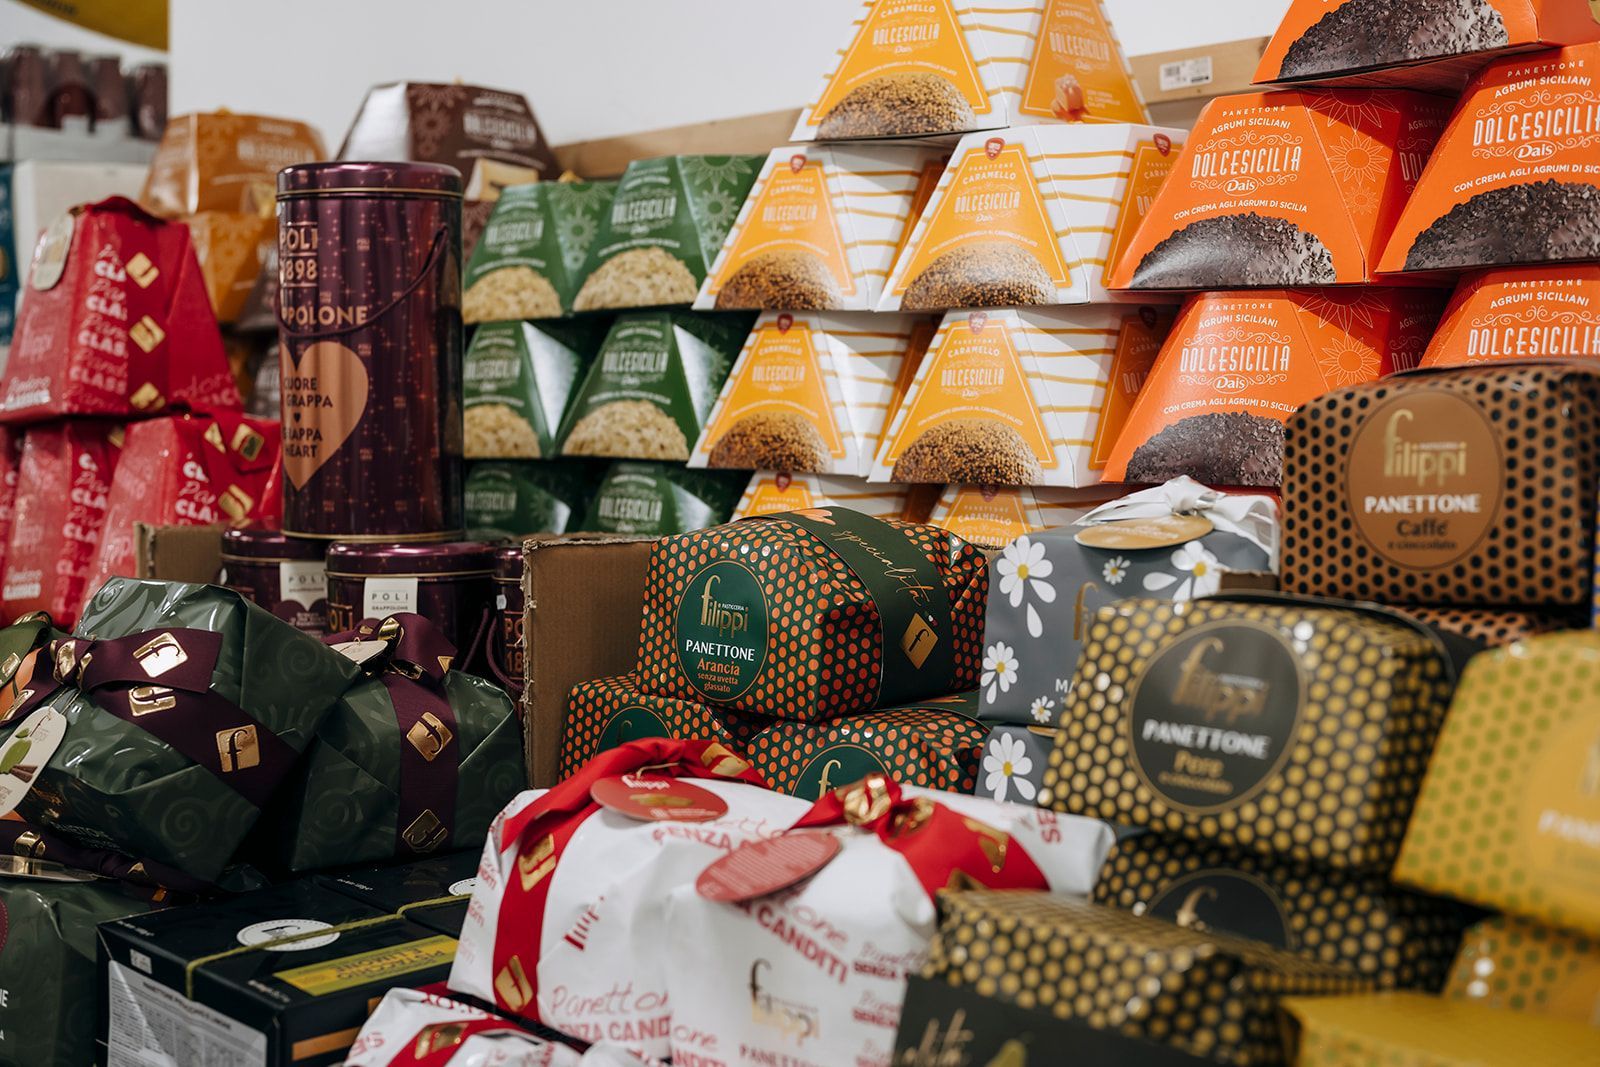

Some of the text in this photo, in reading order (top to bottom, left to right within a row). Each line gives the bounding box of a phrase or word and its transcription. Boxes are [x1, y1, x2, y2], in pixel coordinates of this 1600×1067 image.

[881, 4, 937, 19] CARAMELLO
[872, 23, 941, 46] DOLCESICILIA
[1050, 31, 1110, 62] DOLCESICILIA
[1507, 60, 1584, 77] PANETTONE
[1494, 75, 1591, 99] AGRUMI SICILIANI
[1222, 105, 1286, 117] PANETTONE
[1211, 117, 1290, 136] AGRUMI SICILIANI
[1518, 142, 1554, 159] Dais
[1191, 145, 1302, 179] DOLCESICILIA
[962, 171, 1017, 185] CARAMELLO
[1226, 179, 1257, 193] Dais
[1453, 180, 1474, 193] CON
[1475, 172, 1507, 187] CREMA
[1509, 167, 1531, 178] AGLI
[1533, 164, 1570, 175] AGRUMI
[1572, 164, 1582, 172] DI
[954, 191, 1021, 213] DOLCESICILIA
[1174, 200, 1308, 221] CON CREMA AGLI AGRUMI DI SICILIA
[1503, 279, 1583, 289] PANETTONE
[1208, 302, 1273, 311] PANETTONE
[1490, 291, 1590, 309] AGRUMI SICILIANI
[1198, 313, 1278, 329] AGRUMI SICILIANI
[947, 345, 1001, 358] CARAMELLO
[1179, 345, 1291, 373] DOLCESICILIA
[941, 367, 1005, 387] DOLCESICILIA
[1215, 376, 1246, 390] Dais
[1163, 403, 1180, 415] CON
[1181, 399, 1207, 411] CREMA
[1208, 398, 1227, 407] AGLI
[1227, 397, 1259, 407] AGRUMI
[1260, 399, 1269, 408] DI
[1384, 408, 1467, 487] filippi
[1364, 493, 1482, 514] PANETTONE
[958, 512, 1012, 526] CARAMELLO
[288, 575, 325, 584] POLI
[371, 592, 409, 601] POLI
[701, 574, 749, 638] filippi
[685, 639, 756, 662] PANETTONE
[697, 657, 741, 676] Arancia
[697, 672, 739, 686] senza uvetta
[704, 680, 732, 693] glassato
[1141, 718, 1273, 761] PANETTONE
[757, 902, 849, 985] CANDITI
